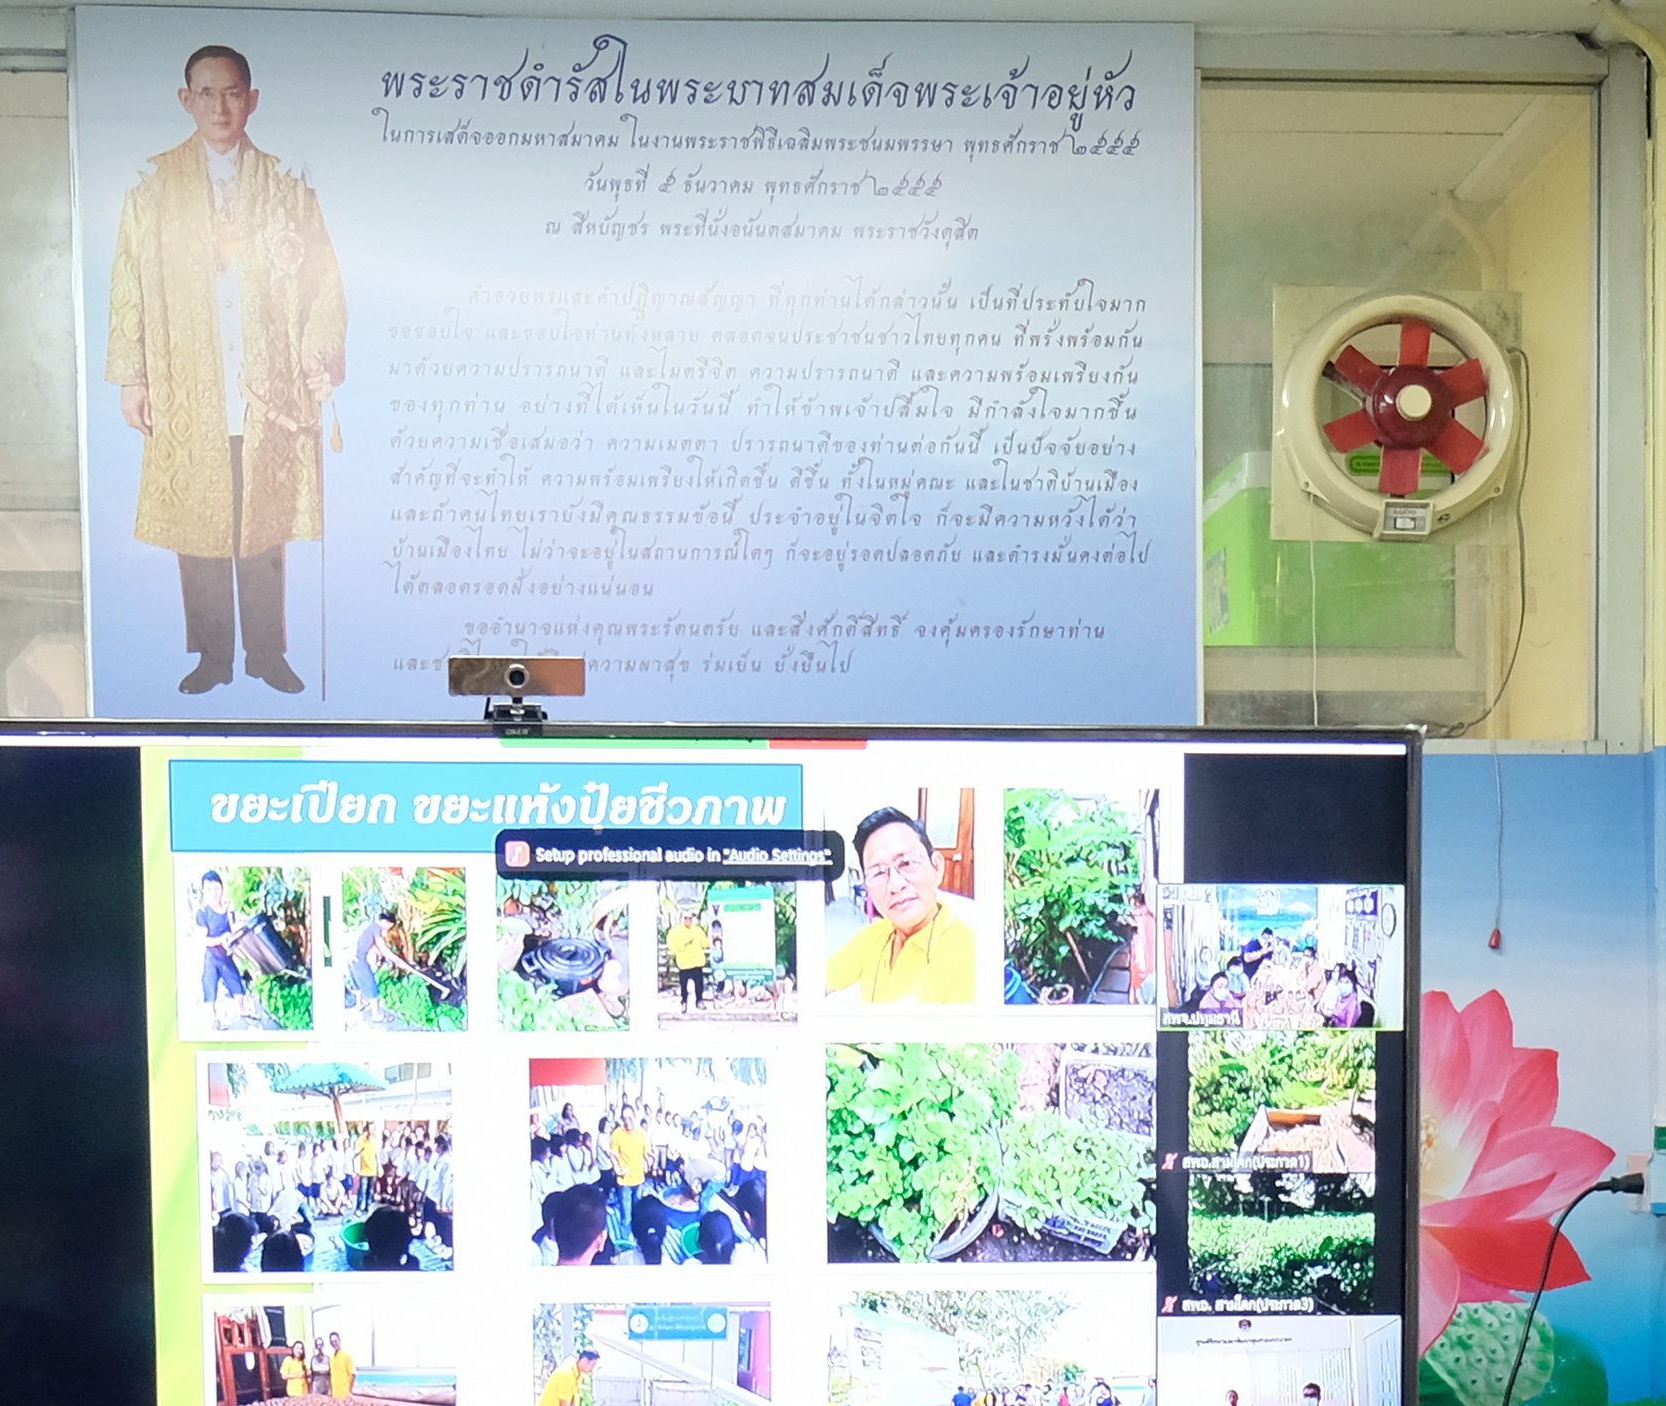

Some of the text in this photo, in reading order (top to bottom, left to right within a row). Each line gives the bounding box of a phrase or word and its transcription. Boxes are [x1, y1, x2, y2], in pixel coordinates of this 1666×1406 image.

[381, 33, 1136, 132] พระราชดำรัสในพระบาทสมเด็จพระเจ้าอยู่หัว
[370, 106, 1142, 162] ในการเสด็จออกมหาสมาคม ในงานพระราชพิธีเฉลิมพระชนมพรรษา พุทธศักราช ๒๕๕๕
[583, 161, 944, 203] วันพุธที่ ๕ ธันวาคม พุทธศักราช ๒๕๕๕
[544, 206, 980, 250] ณ สีหบัญชร พระที่นั่งอนันตสมาคม พระราชวังดุสิต
[210, 778, 788, 834] ขยะเปียก ขยะแห้งปุ๋ยชีวภาพ
[536, 847, 574, 865] Setup
[578, 847, 662, 865] professional
[666, 848, 703, 863] audio
[707, 847, 721, 863] in
